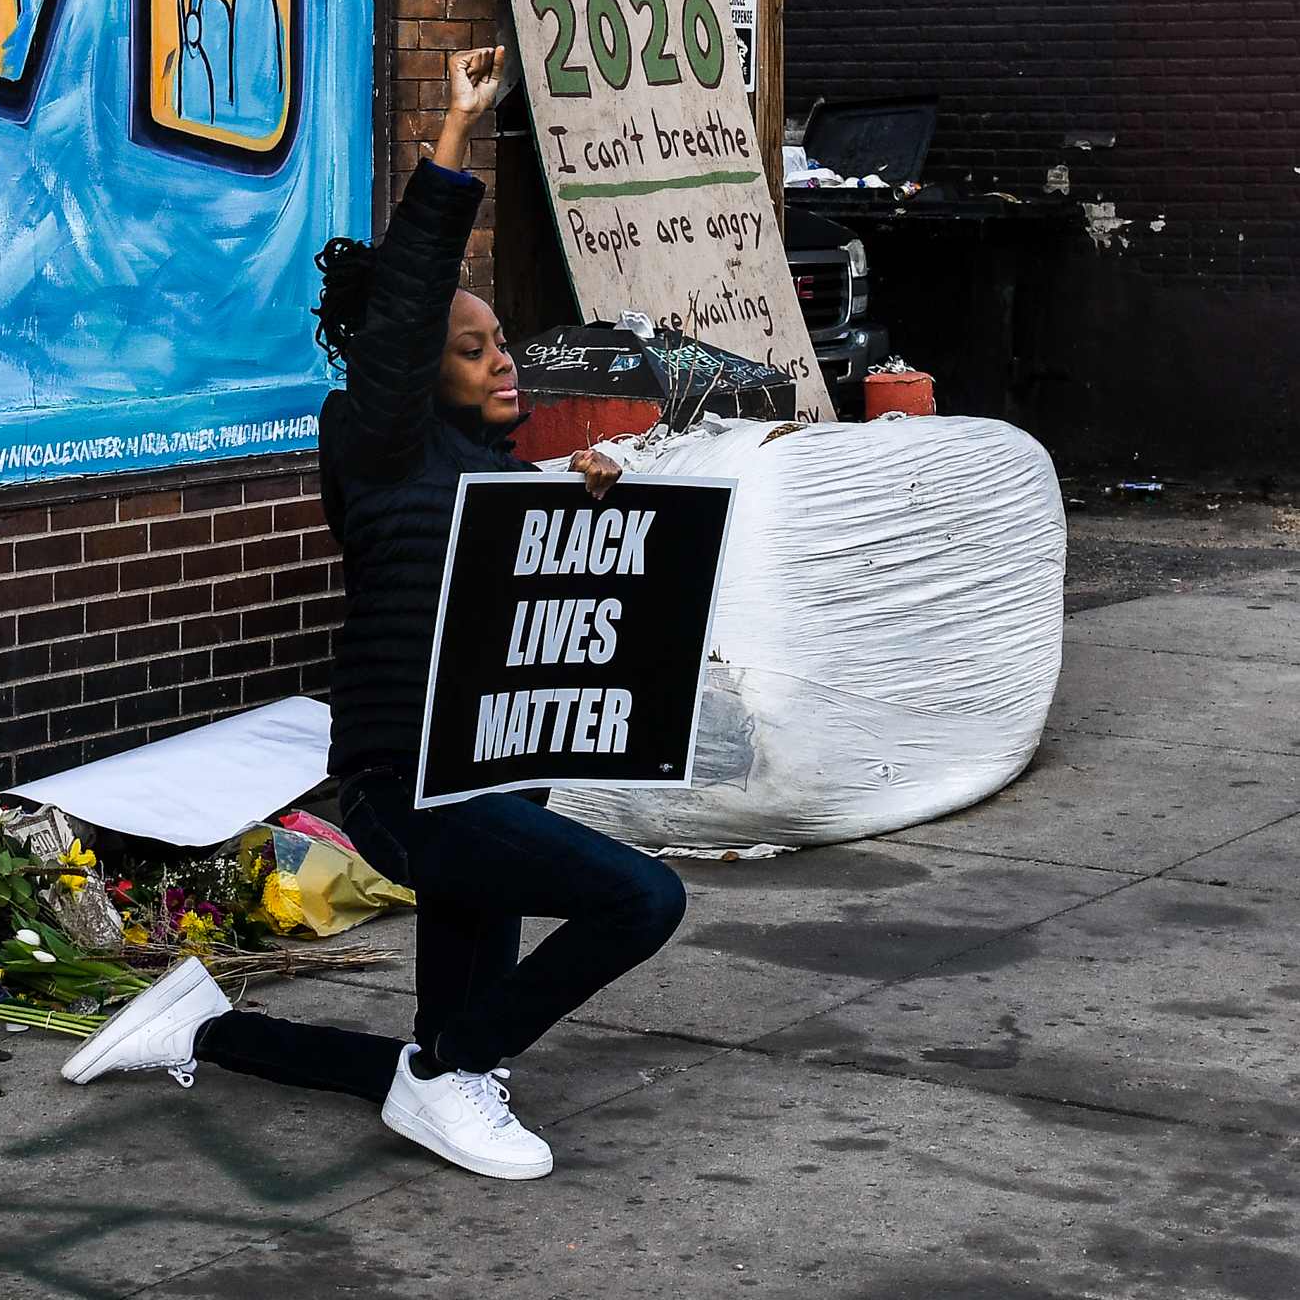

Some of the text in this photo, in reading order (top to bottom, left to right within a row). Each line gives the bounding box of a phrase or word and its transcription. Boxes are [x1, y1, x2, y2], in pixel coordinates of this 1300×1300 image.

[548, 107, 750, 174] I can't breathe
[567, 206, 763, 274] People are angry
[513, 508, 656, 576] BLACK
[506, 598, 622, 667] LIVES
[473, 688, 632, 762] MATTER
